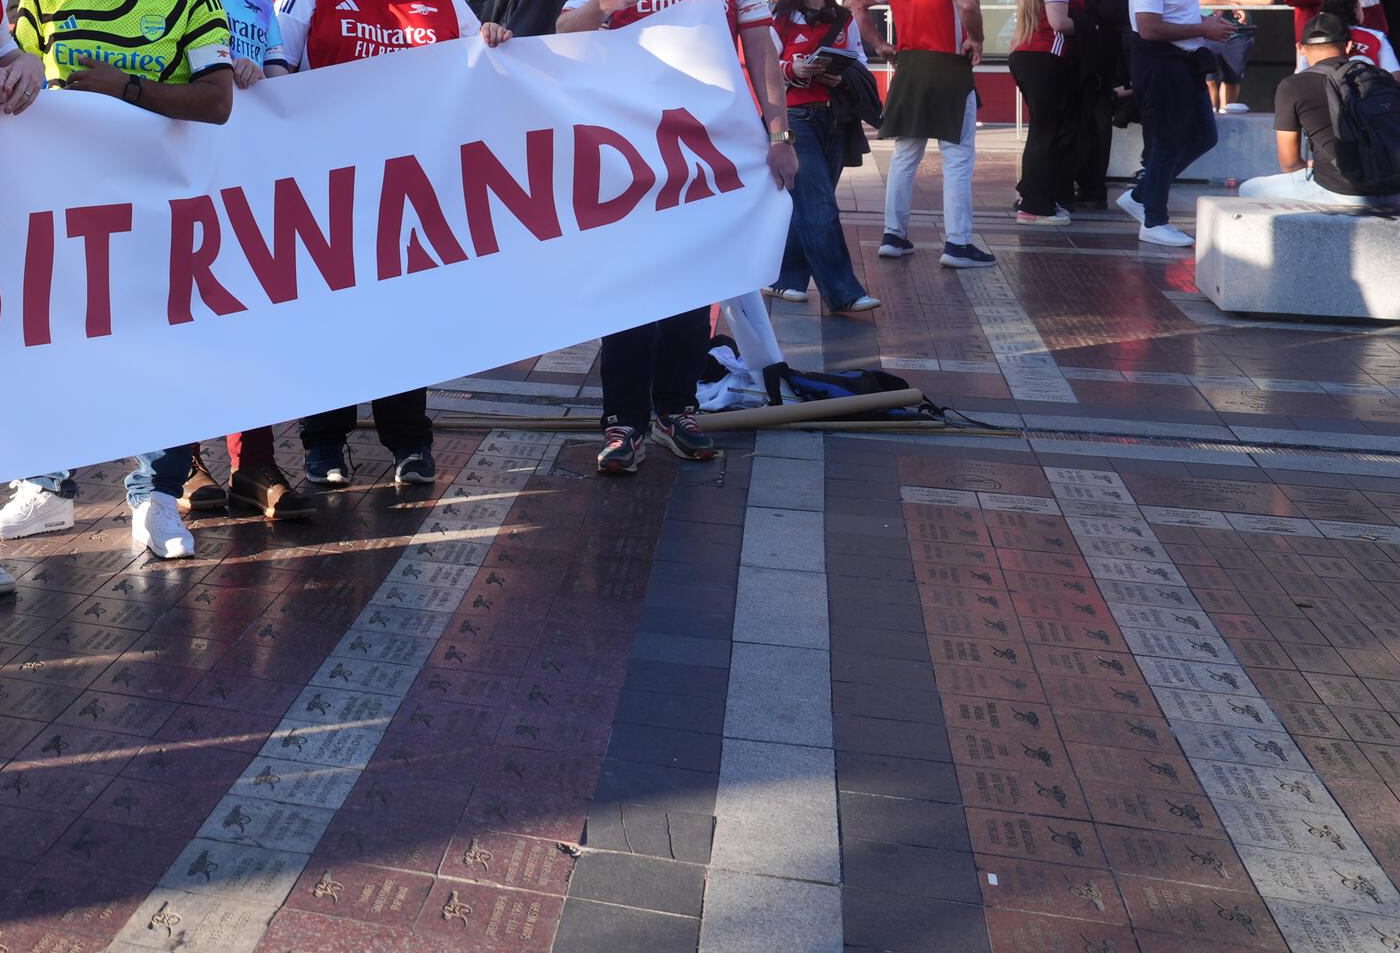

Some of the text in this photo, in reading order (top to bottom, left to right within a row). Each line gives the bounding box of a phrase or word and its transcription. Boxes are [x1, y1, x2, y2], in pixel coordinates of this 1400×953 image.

[226, 11, 268, 48] irates
[340, 19, 437, 45] Emirates
[55, 42, 167, 73] Emirates
[354, 40, 376, 58] FLY
[168, 107, 745, 326] RWANDA
